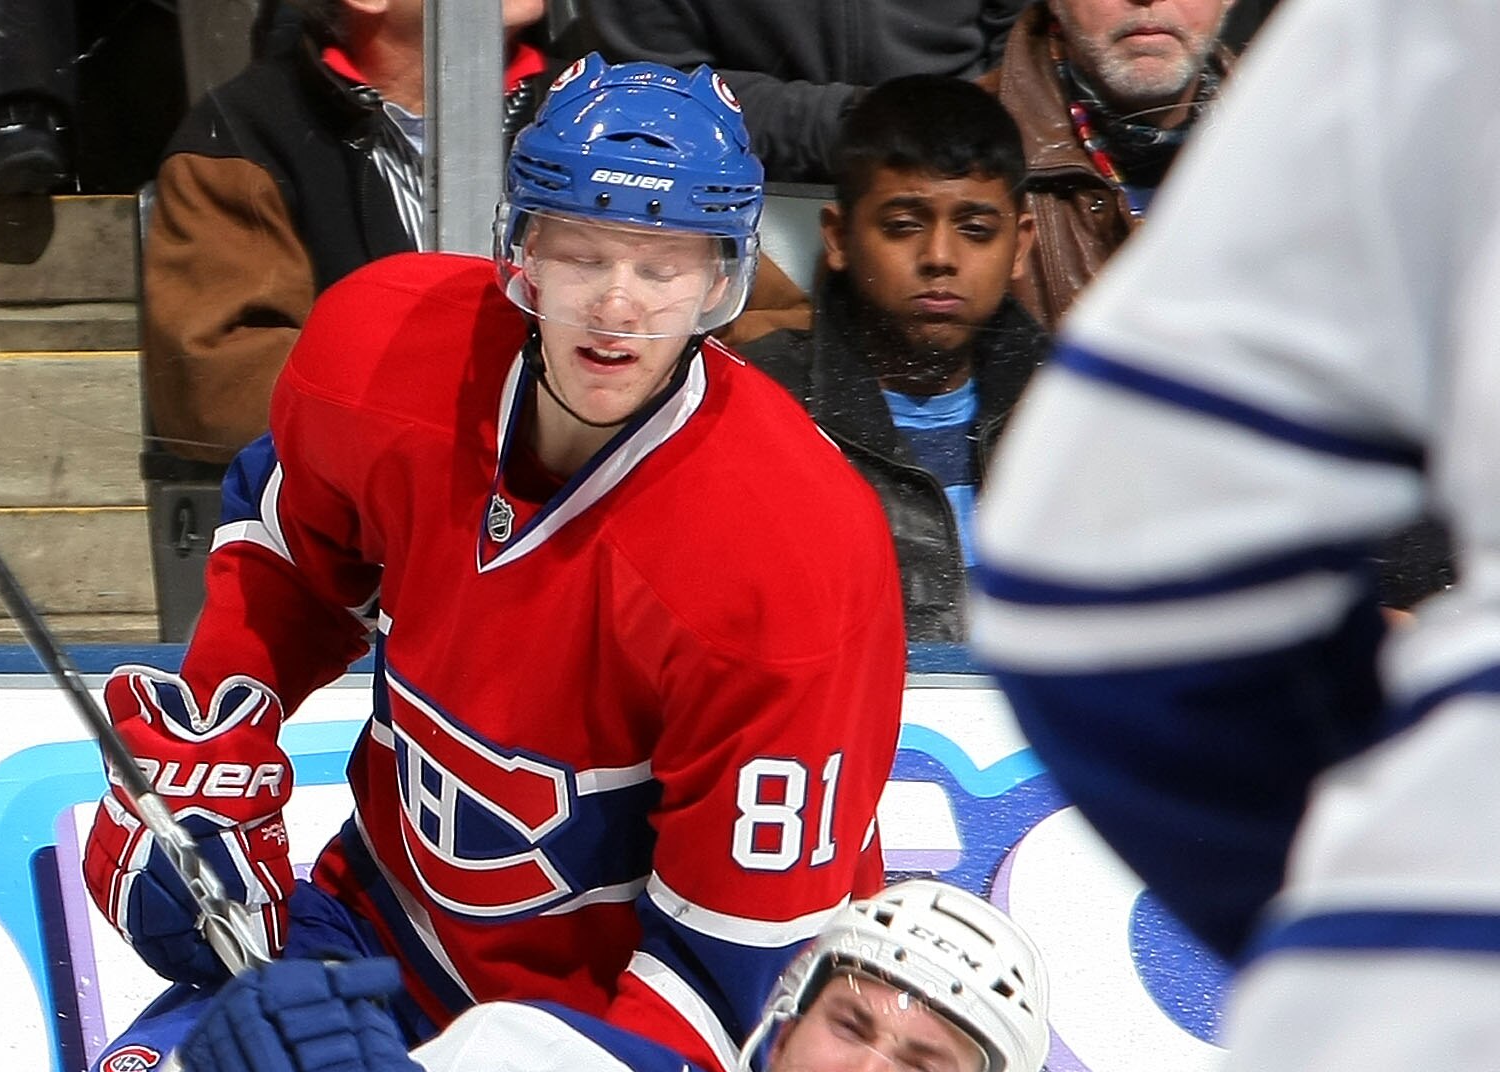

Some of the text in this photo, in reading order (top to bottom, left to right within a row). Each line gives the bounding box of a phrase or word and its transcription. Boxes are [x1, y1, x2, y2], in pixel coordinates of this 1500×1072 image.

[590, 168, 676, 192] BAUER
[731, 750, 844, 874] 81
[906, 924, 983, 972] CCM
